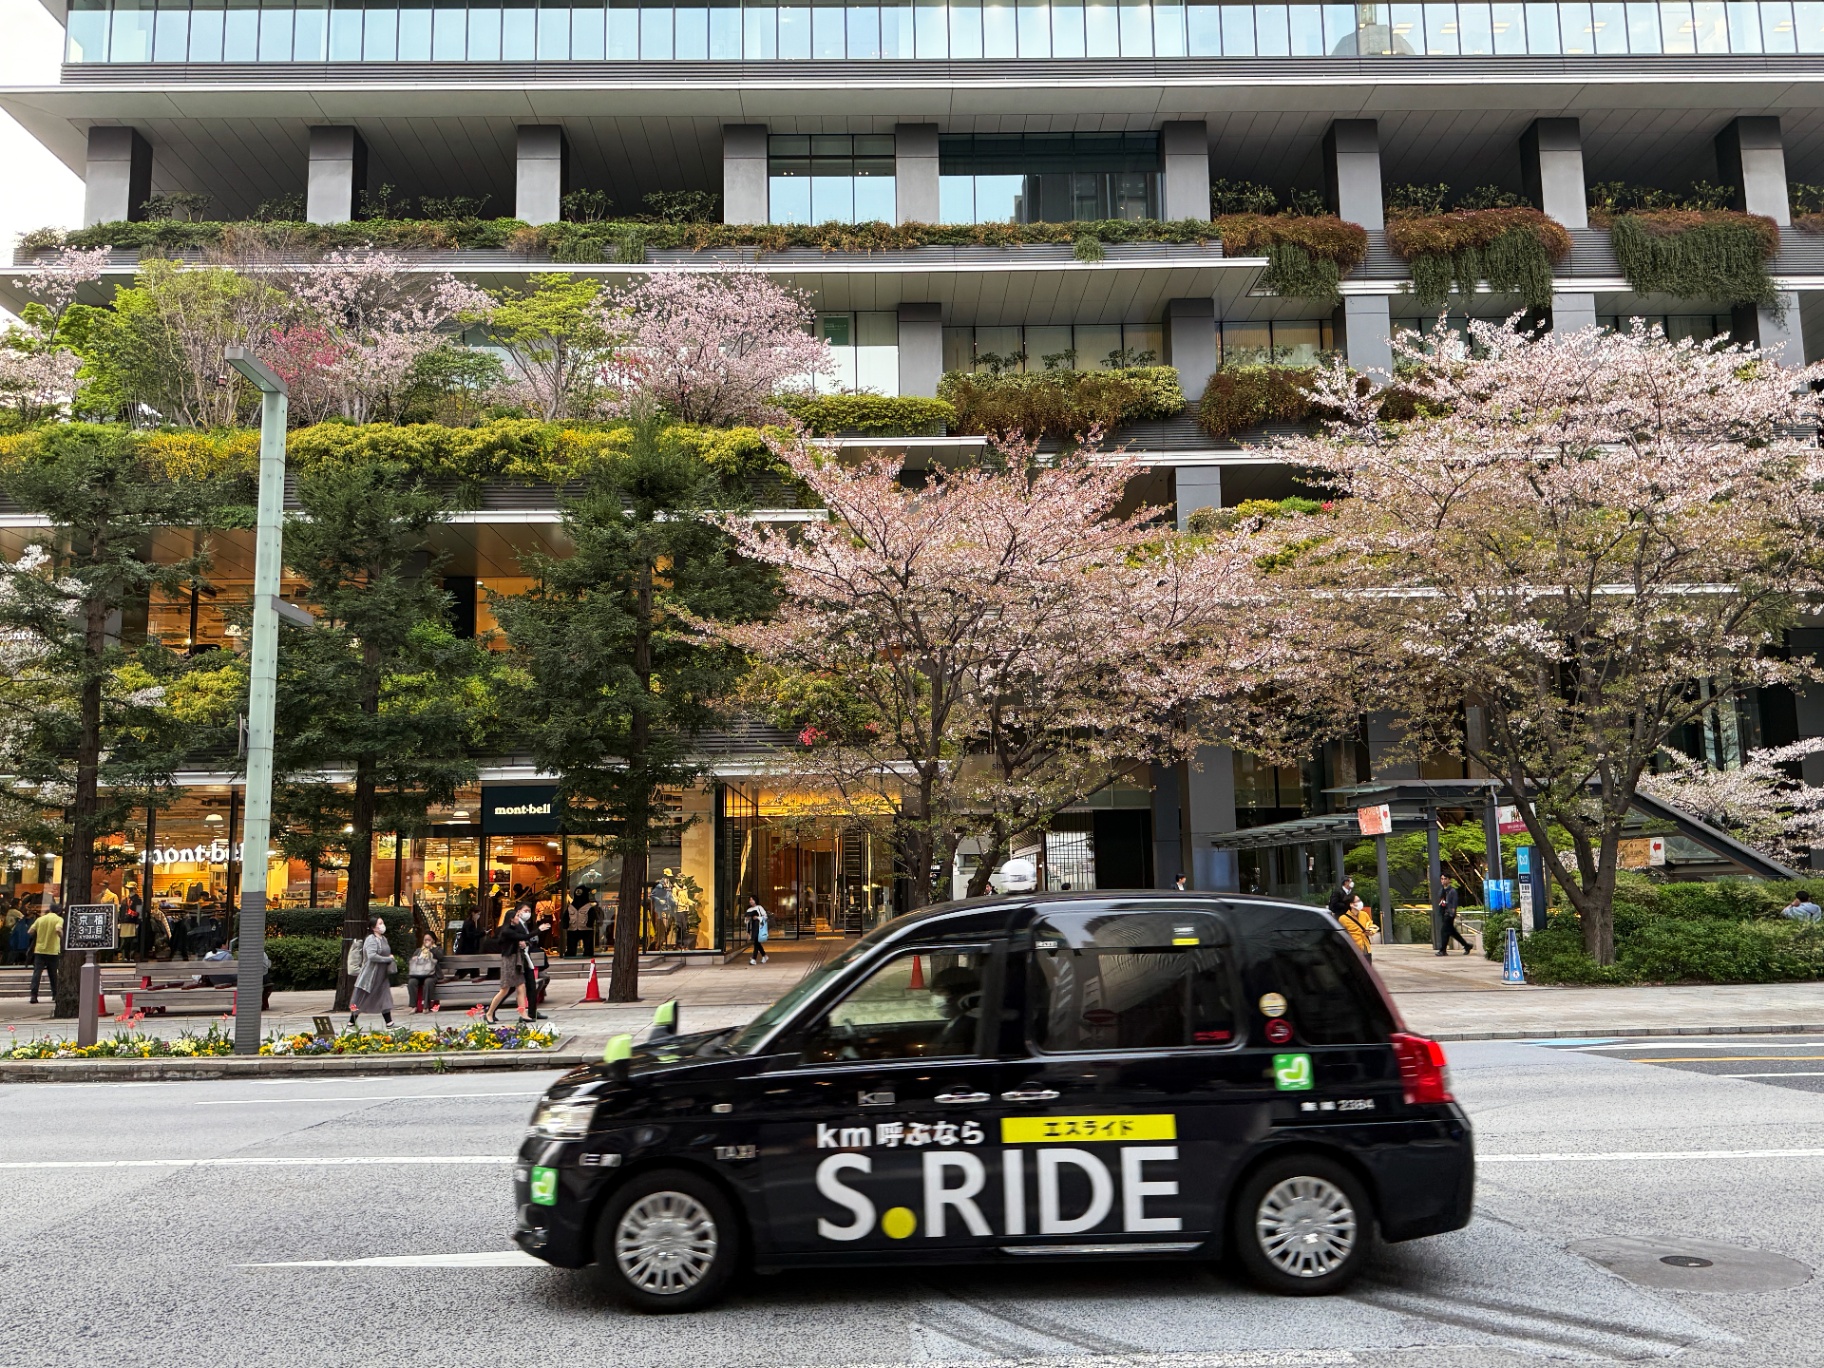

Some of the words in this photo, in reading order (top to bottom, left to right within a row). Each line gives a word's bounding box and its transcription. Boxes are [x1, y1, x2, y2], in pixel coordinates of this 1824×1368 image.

[78, 926, 102, 934] 3丁目
[1043, 1119, 1134, 1137] エスライド
[815, 1145, 1183, 1242] S.RIDE
